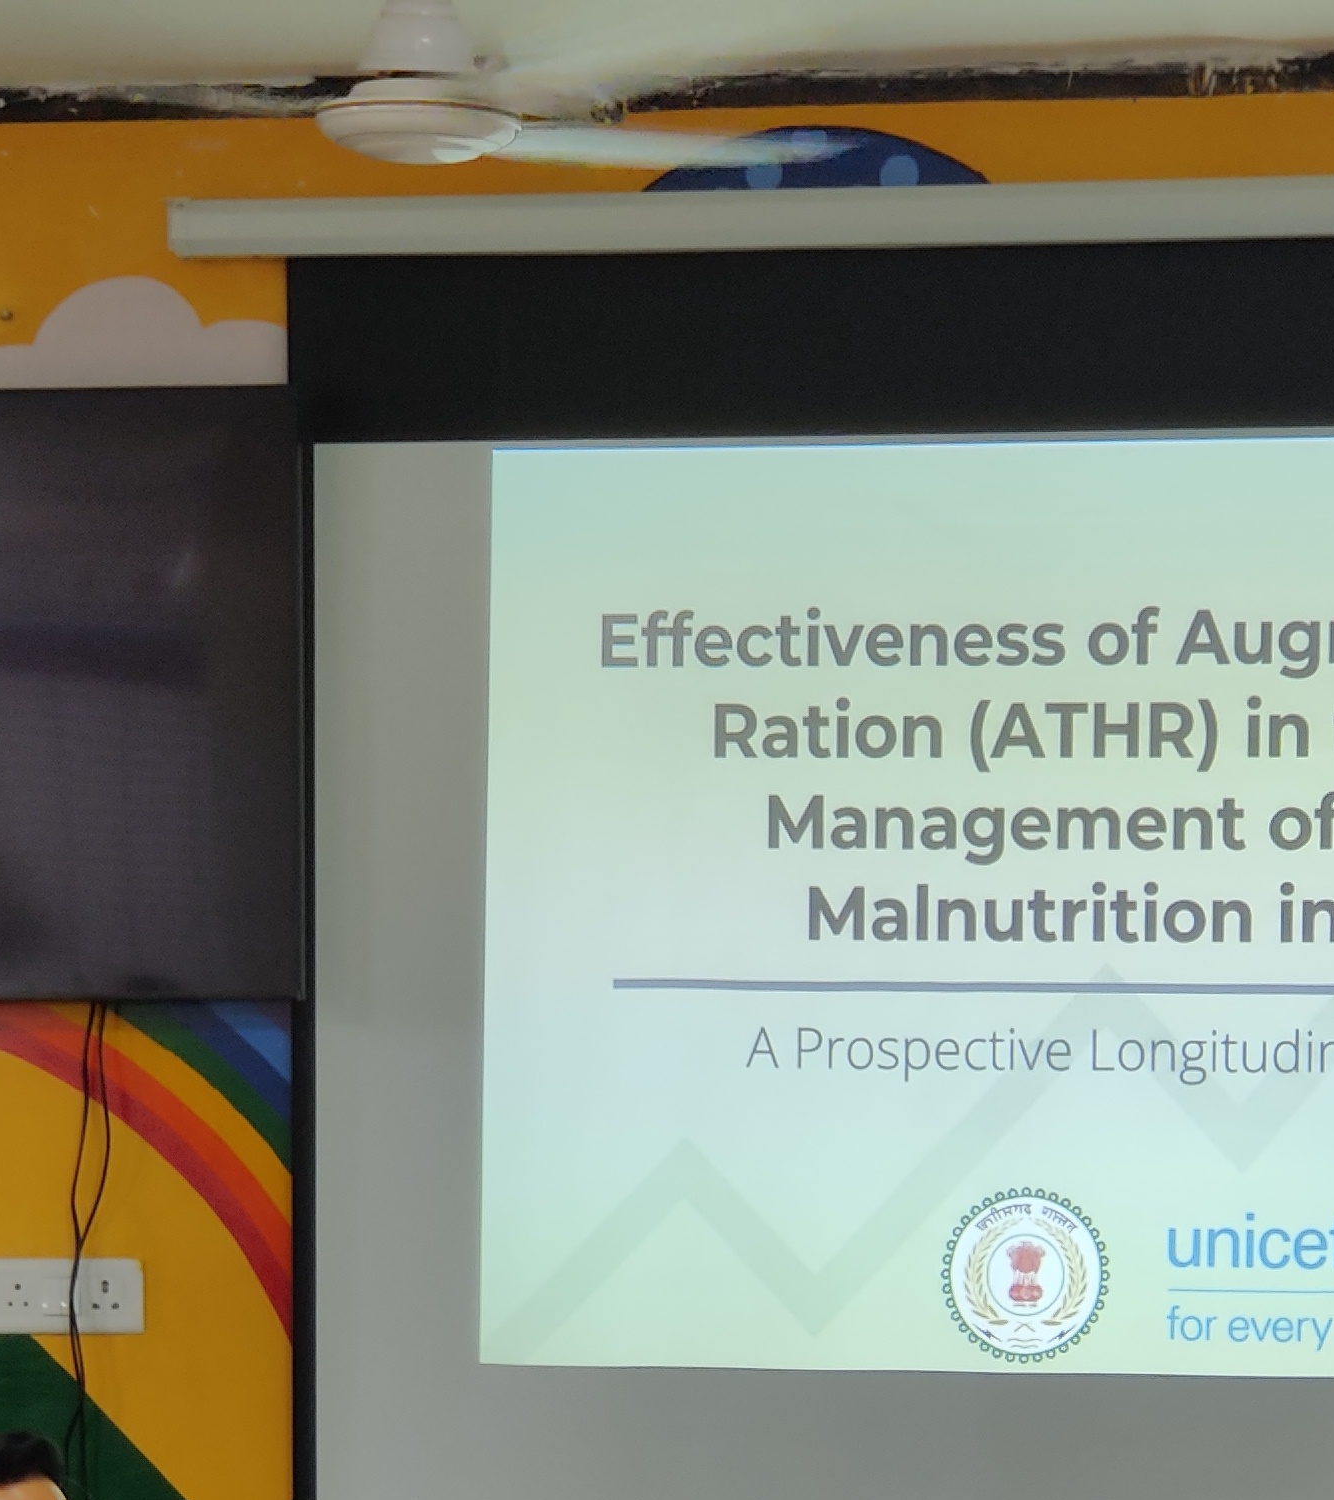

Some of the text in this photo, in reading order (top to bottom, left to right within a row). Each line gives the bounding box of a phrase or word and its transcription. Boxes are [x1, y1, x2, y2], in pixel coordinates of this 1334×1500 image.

[600, 605, 1065, 667] Effectiveness
[1086, 605, 1161, 666] of
[714, 697, 942, 758] Ration
[970, 698, 1218, 772] (ATHR)
[1246, 695, 1309, 757] in
[768, 794, 1246, 863] Management
[808, 881, 1252, 943] Malnutrition
[745, 1026, 780, 1070] A
[797, 1026, 1072, 1083] Prospective
[1167, 1304, 1218, 1342] for
[1228, 1312, 1333, 1352] every
